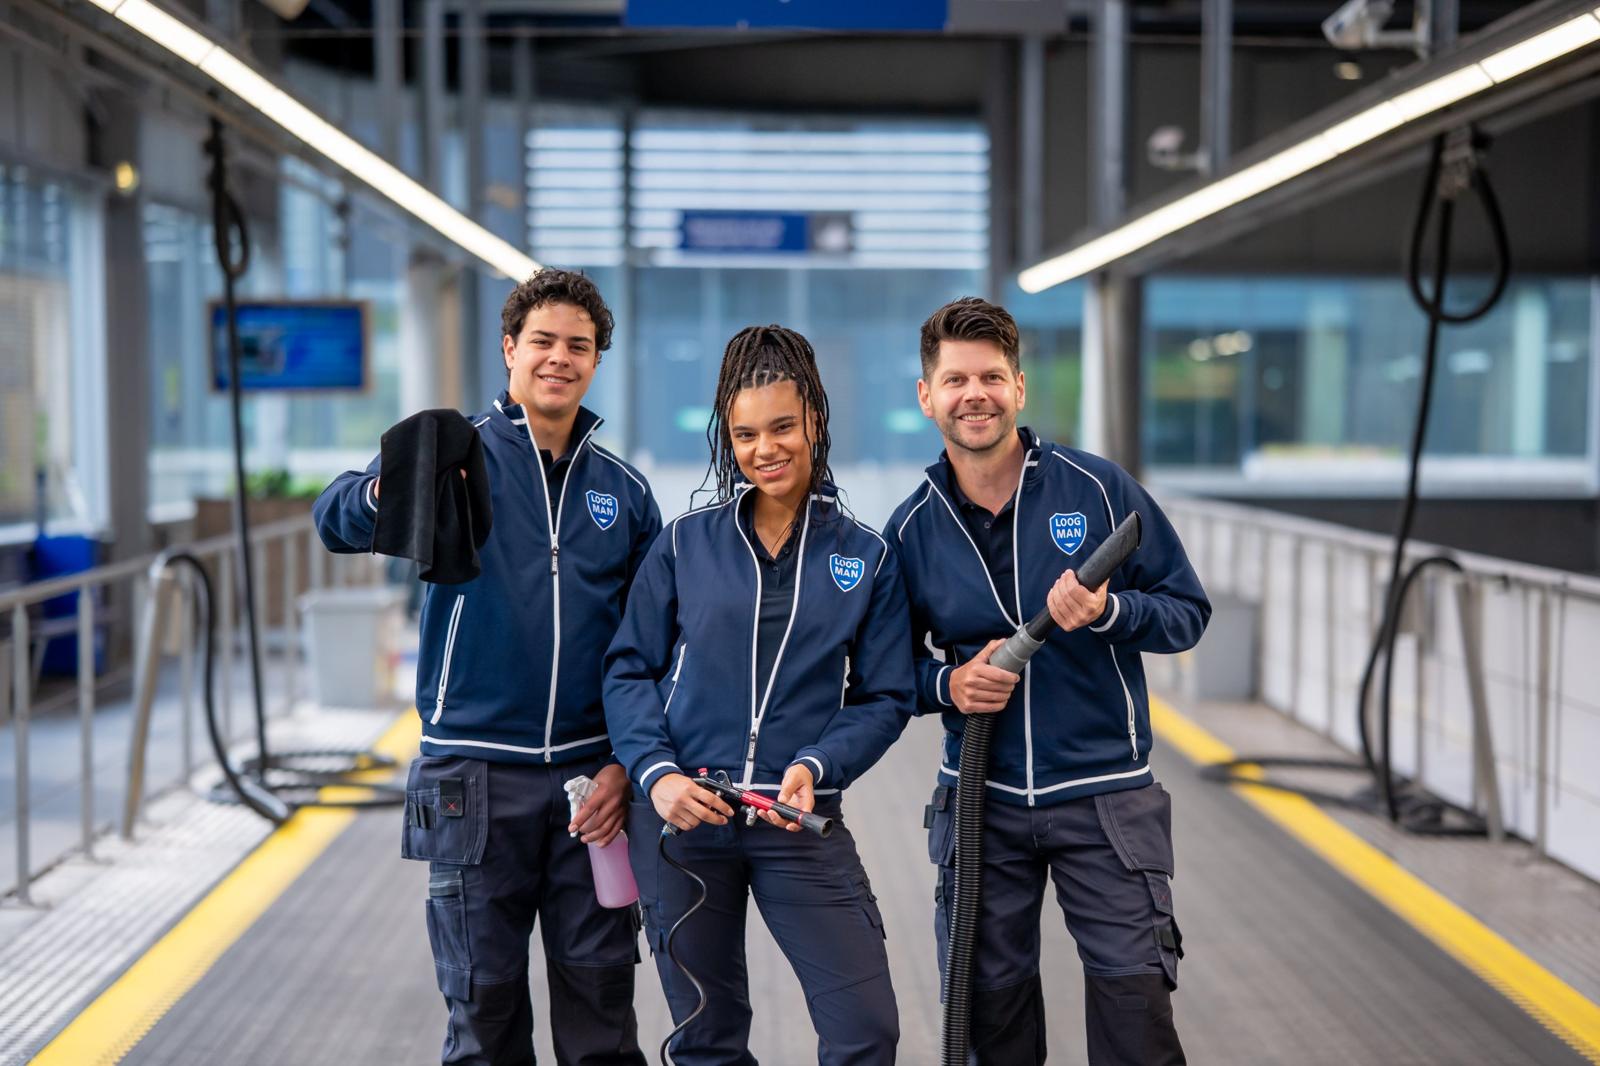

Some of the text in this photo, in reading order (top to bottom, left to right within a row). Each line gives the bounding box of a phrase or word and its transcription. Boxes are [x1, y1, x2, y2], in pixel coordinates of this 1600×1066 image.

[591, 494, 613, 506] LOOG
[592, 504, 613, 516] MAN
[1055, 517, 1081, 527] LOOG
[1056, 528, 1082, 539] MAN
[834, 557, 859, 569] LOOG
[834, 566, 859, 578] MAN
